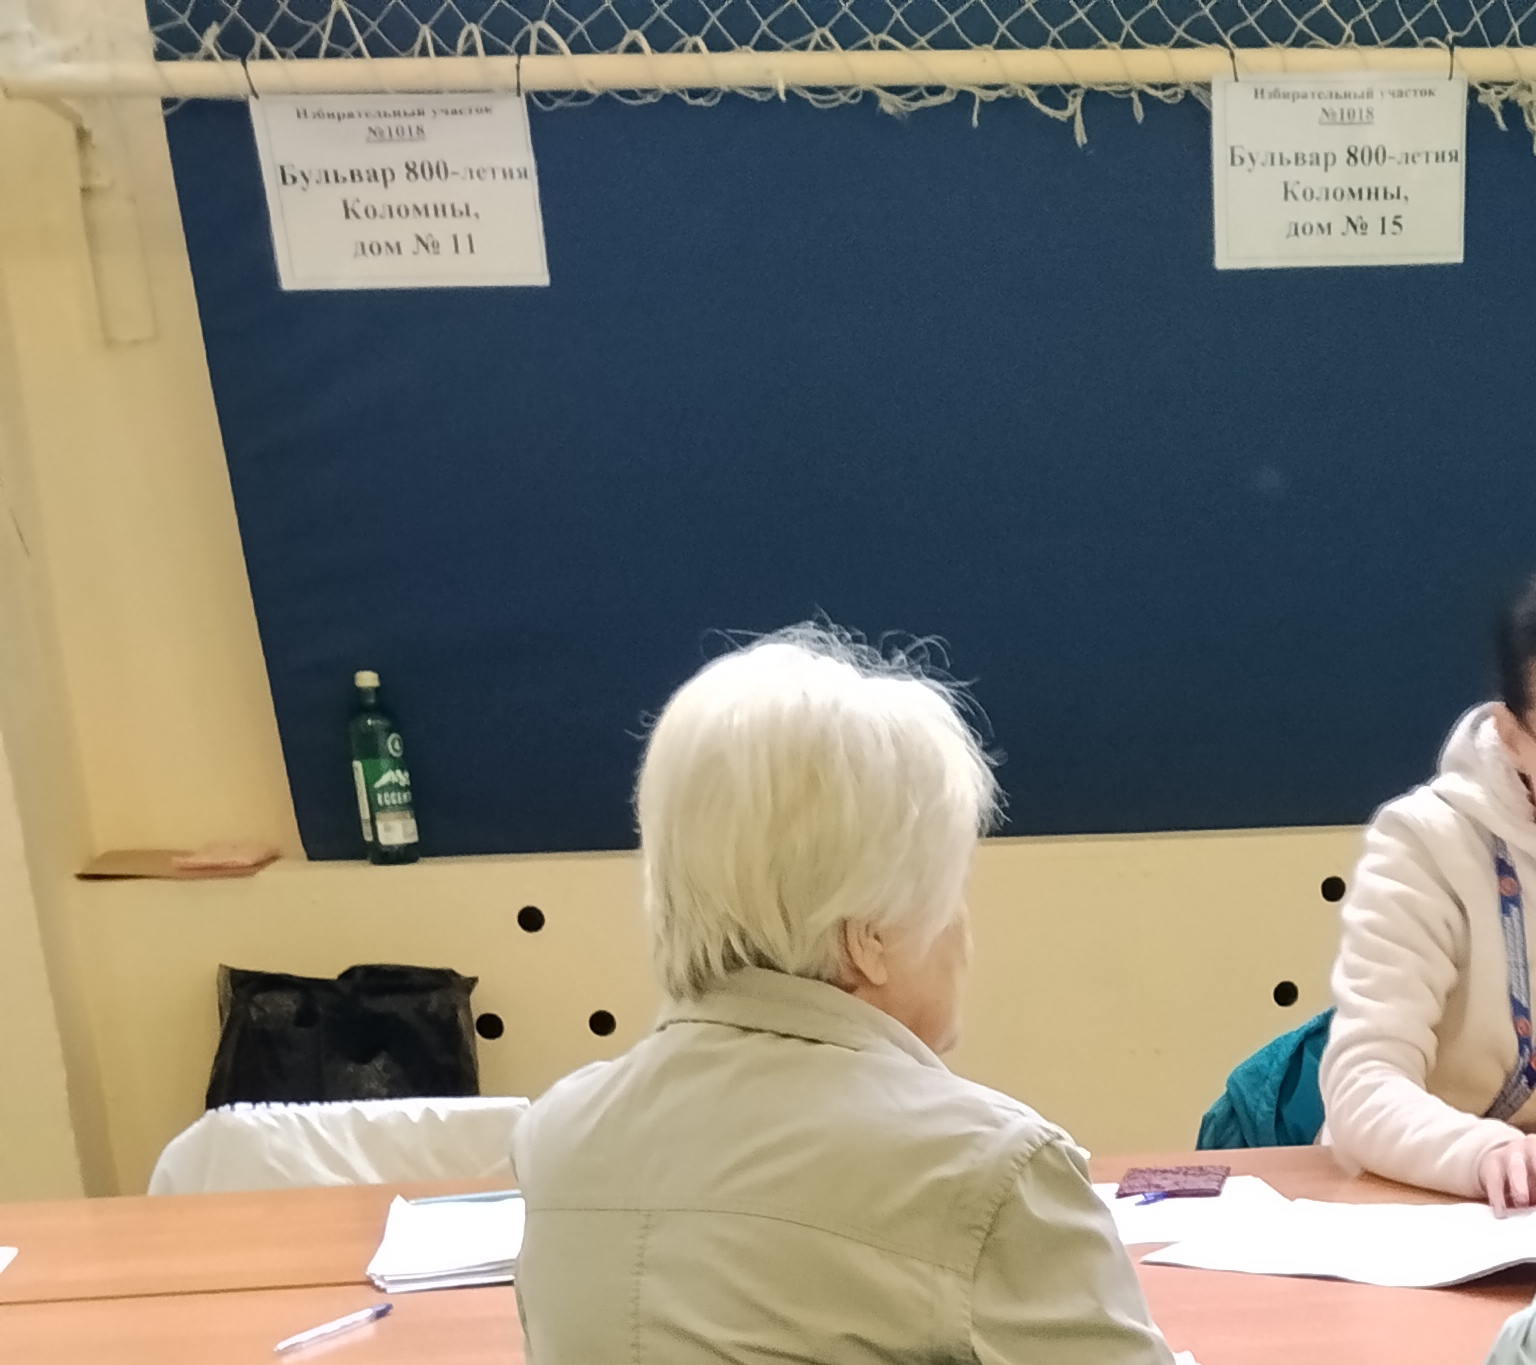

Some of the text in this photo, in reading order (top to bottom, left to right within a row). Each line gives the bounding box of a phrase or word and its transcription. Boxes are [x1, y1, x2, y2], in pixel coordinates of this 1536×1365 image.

[1253, 87, 1437, 103] Избирательный участок
[295, 104, 494, 122] Избирательный участок
[1319, 106, 1375, 125] №1018
[366, 124, 426, 143] №1018
[1228, 144, 1459, 173] Бульвар 800-летия
[278, 159, 528, 191] Бульвар 800-летия
[1282, 180, 1409, 204] Коломны,
[342, 198, 480, 221] Коломны,
[1285, 214, 1404, 239] дом № 15
[353, 233, 477, 259] дом № 11
